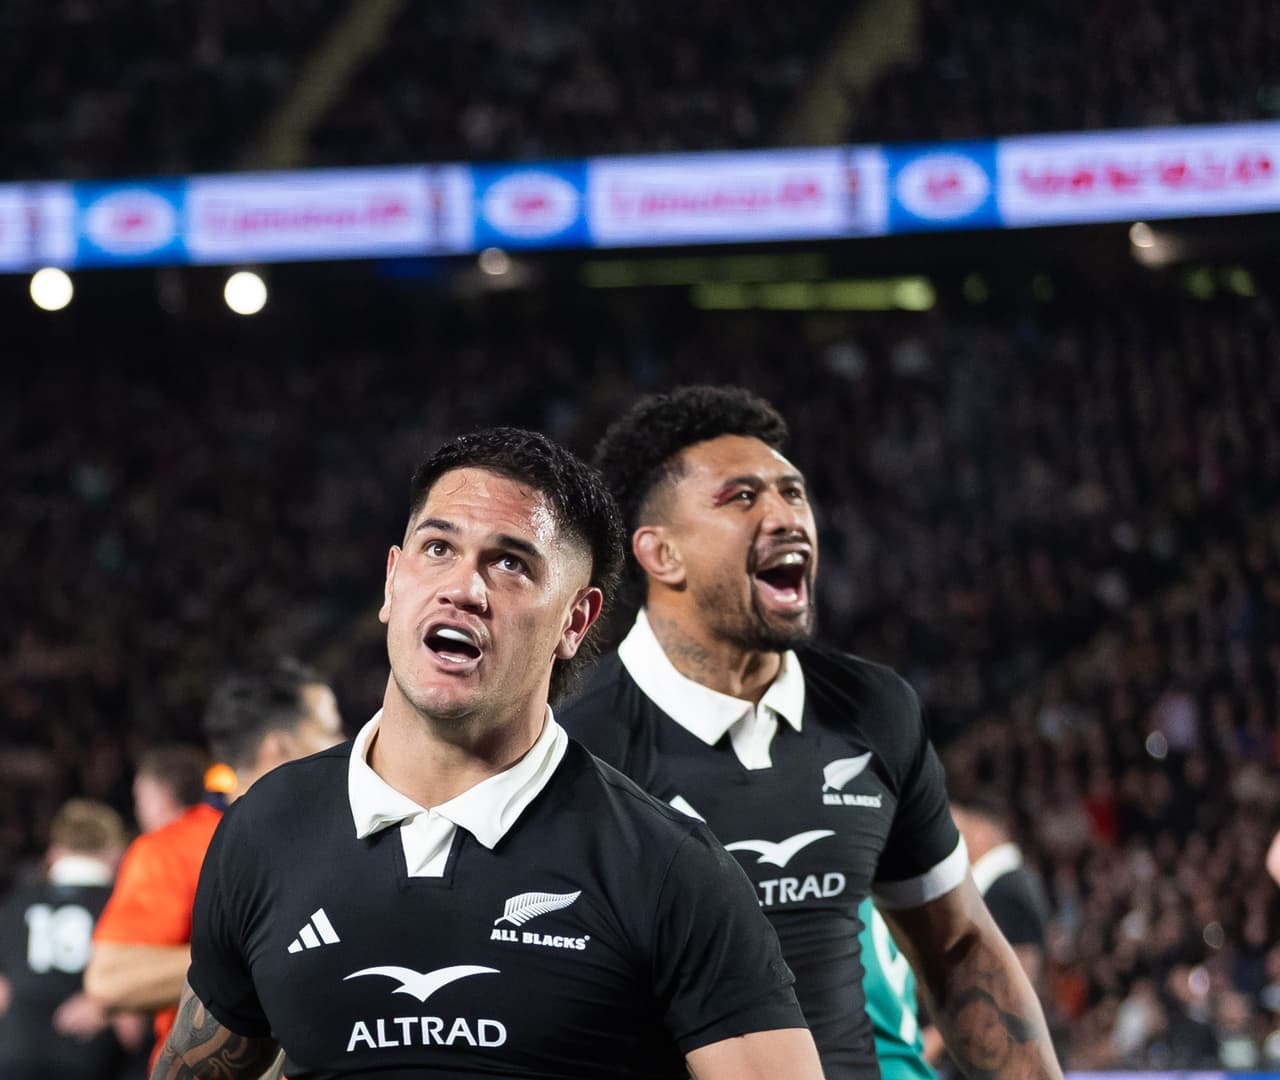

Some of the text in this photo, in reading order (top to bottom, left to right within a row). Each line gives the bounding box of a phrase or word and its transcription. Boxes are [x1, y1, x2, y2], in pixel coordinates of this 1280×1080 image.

[758, 872, 846, 907] TRAD
[490, 929, 586, 950] ALL BLACKS
[346, 1016, 508, 1052] ALTRAD
